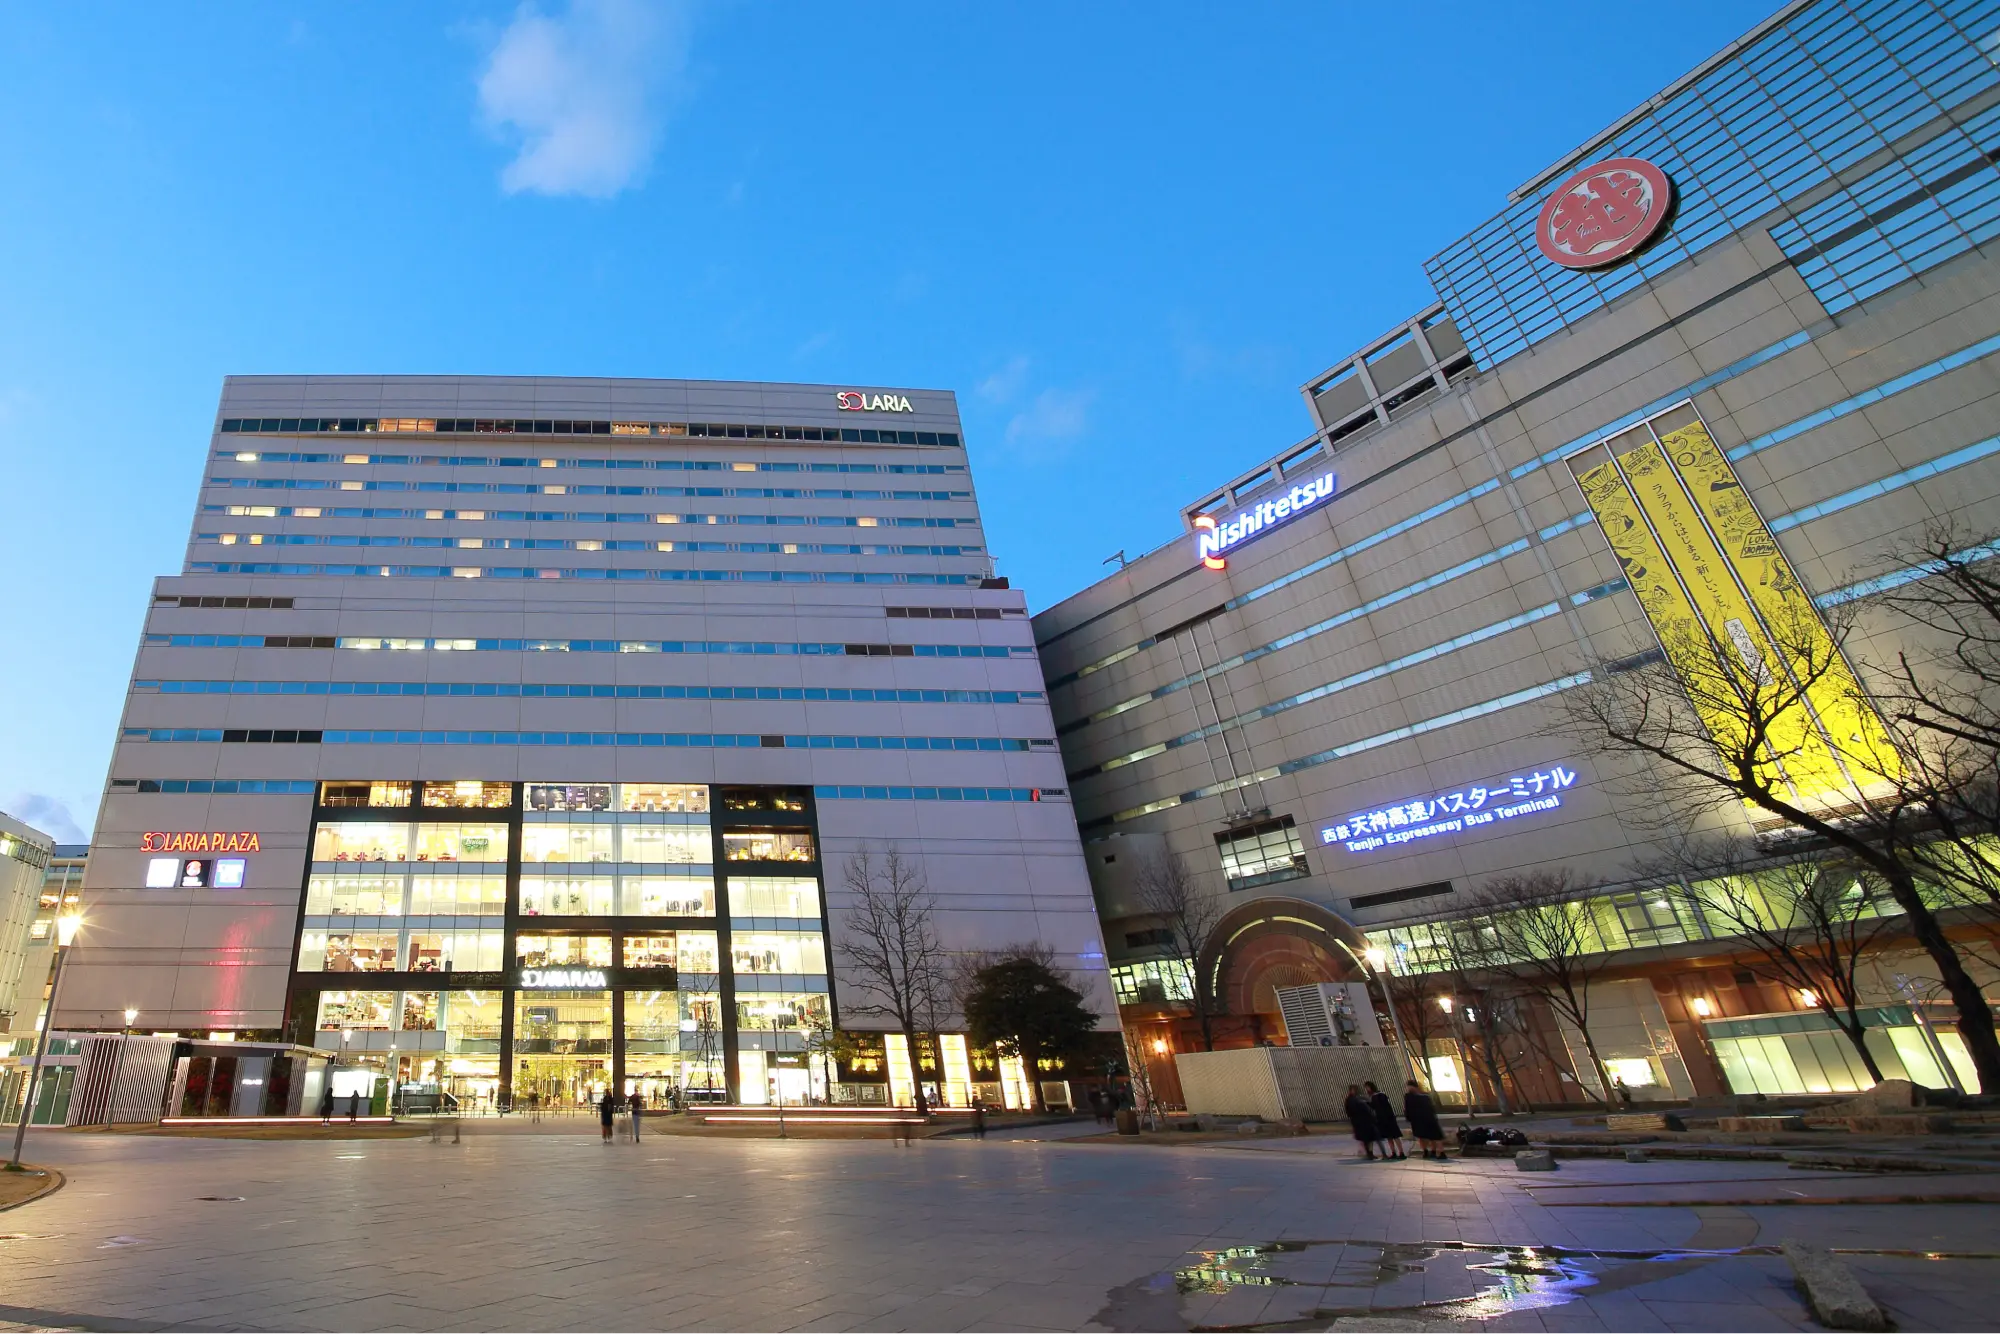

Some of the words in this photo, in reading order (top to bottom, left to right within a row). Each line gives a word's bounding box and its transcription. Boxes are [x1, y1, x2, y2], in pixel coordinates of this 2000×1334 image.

[836, 391, 914, 413] SOLARIA
[1195, 472, 1335, 569] Nishitetsu
[140, 832, 208, 852] SOLARIA
[210, 832, 260, 852] PLAZA
[1345, 836, 1384, 852] Tenjin
[1385, 818, 1462, 844] Expressway
[1465, 812, 1493, 827] Bus
[1497, 795, 1560, 819] Terminal
